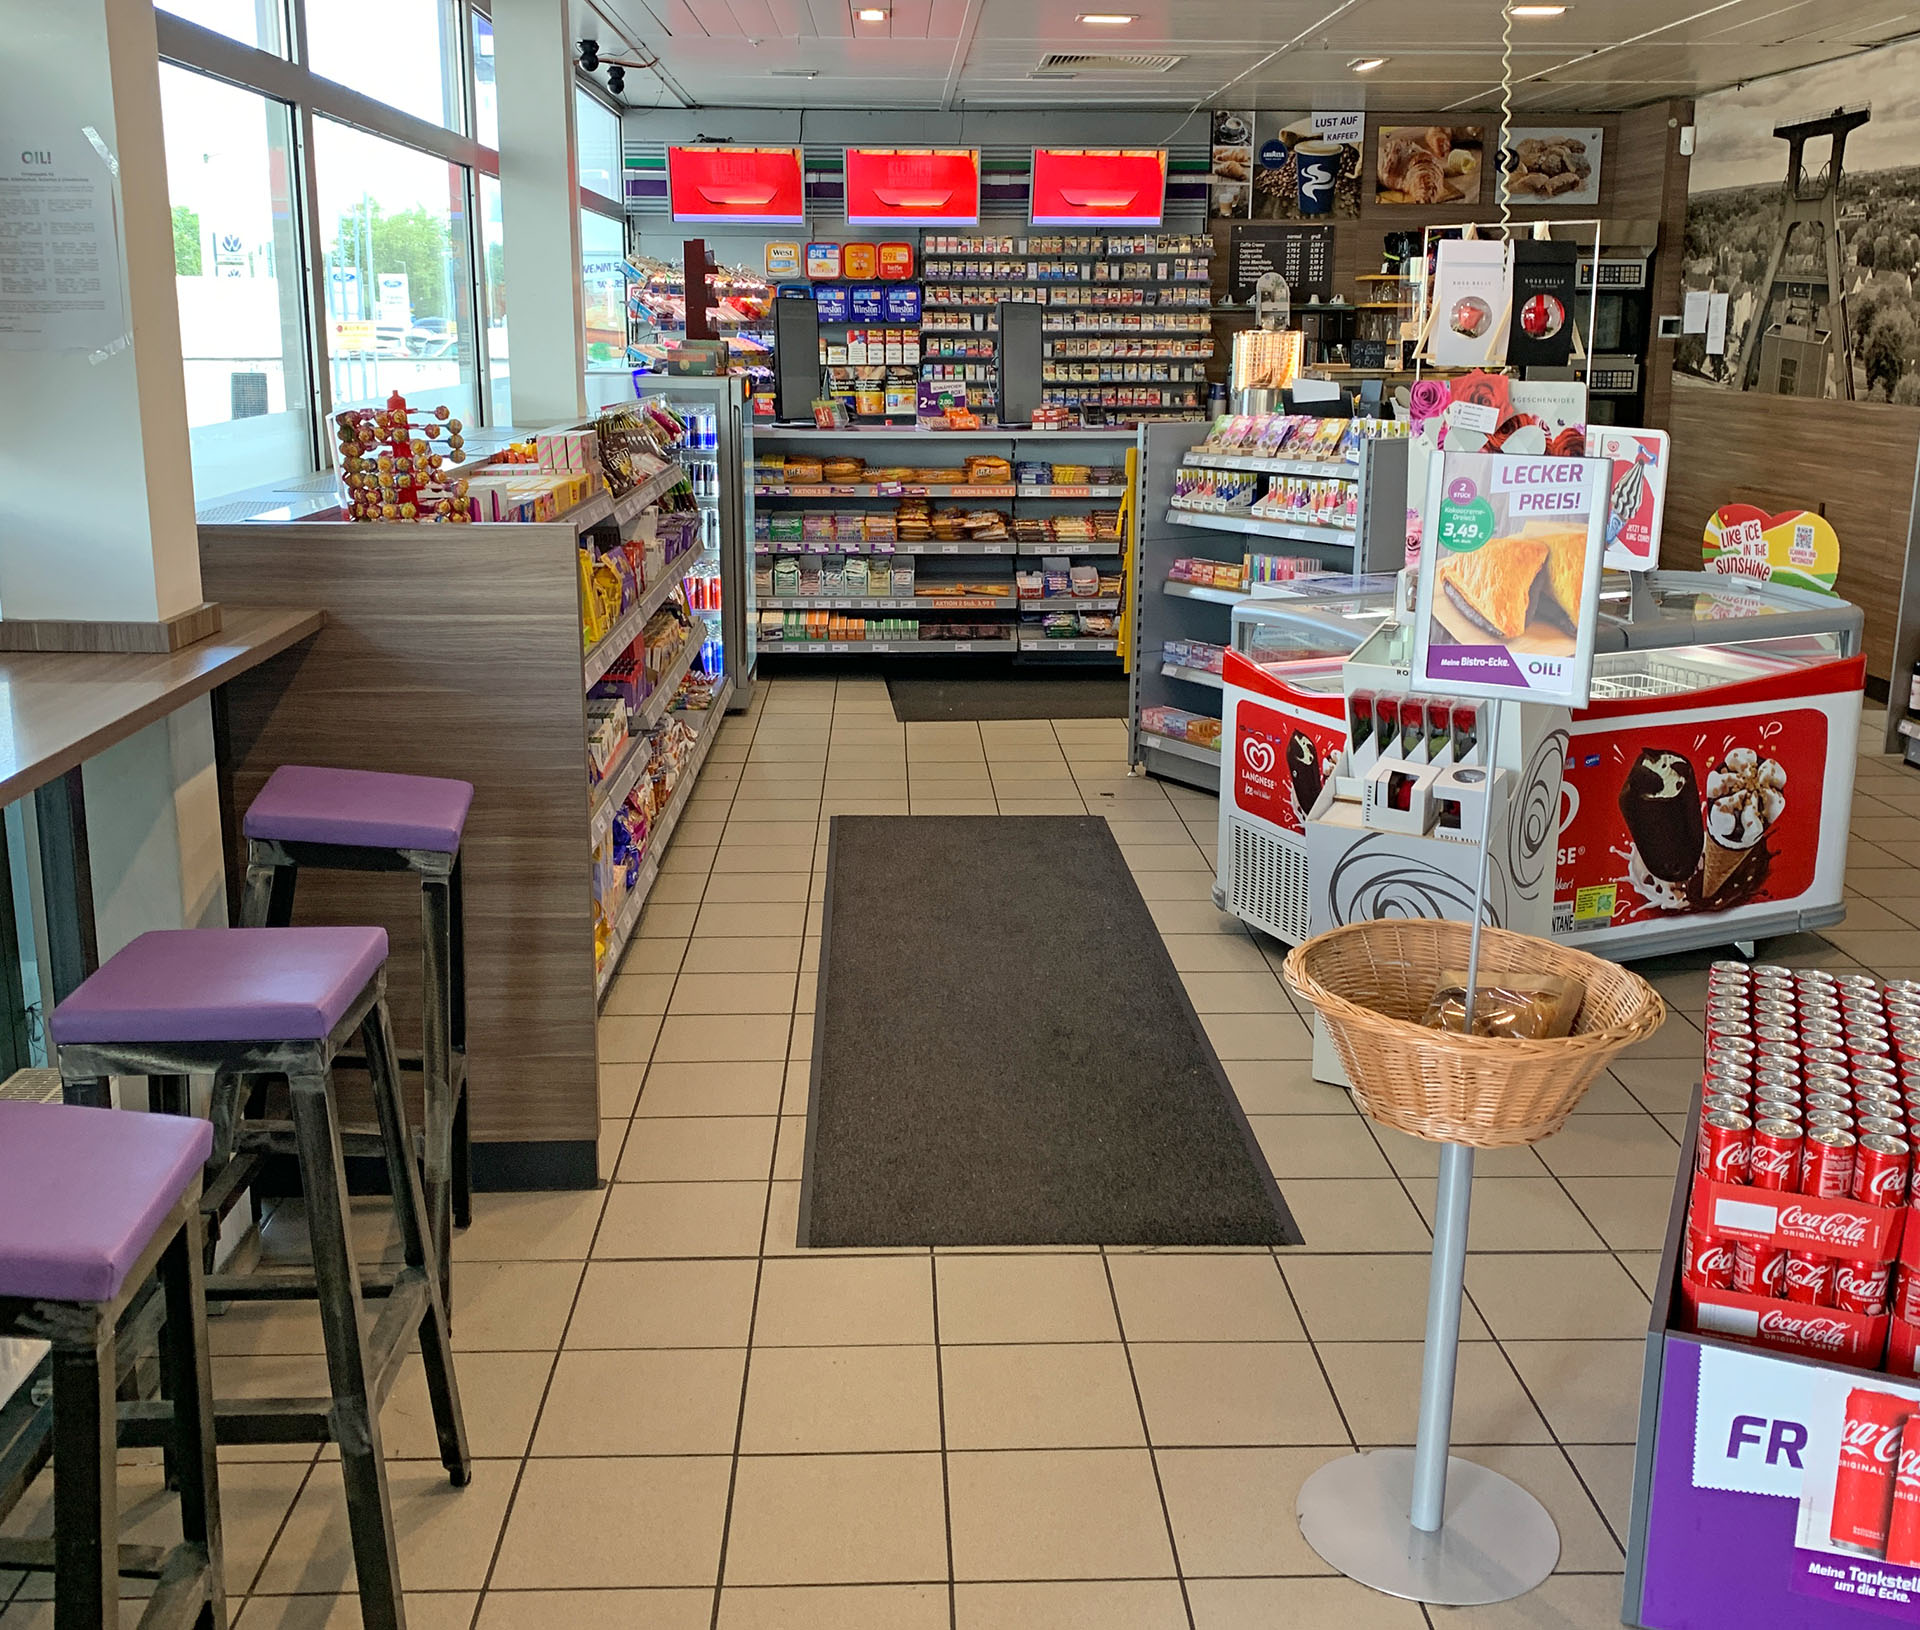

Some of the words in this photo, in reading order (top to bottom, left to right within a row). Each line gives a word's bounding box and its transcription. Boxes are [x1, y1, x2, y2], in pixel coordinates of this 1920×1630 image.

[1315, 118, 1338, 128] LUST
[1340, 116, 1358, 126] AUF
[1326, 131, 1358, 141] KAFFEE?
[21, 151, 52, 164] OIL!
[772, 249, 793, 257] West
[818, 305, 841, 313] Winston
[854, 305, 877, 314] Winston
[890, 305, 914, 314] Winston
[920, 397, 928, 408] 2
[1501, 463, 1584, 485] LECKER
[1459, 483, 1467, 491] 2
[1518, 492, 1581, 511] PREIS!
[1443, 522, 1479, 538] 3,49
[1744, 522, 1760, 542] ICE
[1743, 543, 1751, 556] IN
[1754, 543, 1767, 556] THE
[1440, 658, 1460, 667] Meine
[1460, 657, 1510, 668] Bistro-Ecke.
[1528, 661, 1562, 677] OIL!
[1241, 768, 1275, 790] LANGNESE
[1778, 1204, 1872, 1243] Coca-Cola
[1782, 1230, 1827, 1242] ORIGINAL
[1829, 1236, 1859, 1248] TASTE
[1759, 1310, 1852, 1346] Coca-Cola
[1763, 1333, 1807, 1346] ORIGINAL
[1808, 1340, 1839, 1352] TASTE
[1726, 1414, 1809, 1470] FR
[1808, 1562, 1846, 1580] Meine
[1849, 1566, 1920, 1593] Tankstell
[1834, 1580, 1855, 1593] um
[1857, 1582, 1876, 1597] die
[1878, 1586, 1911, 1604] Ecke.
